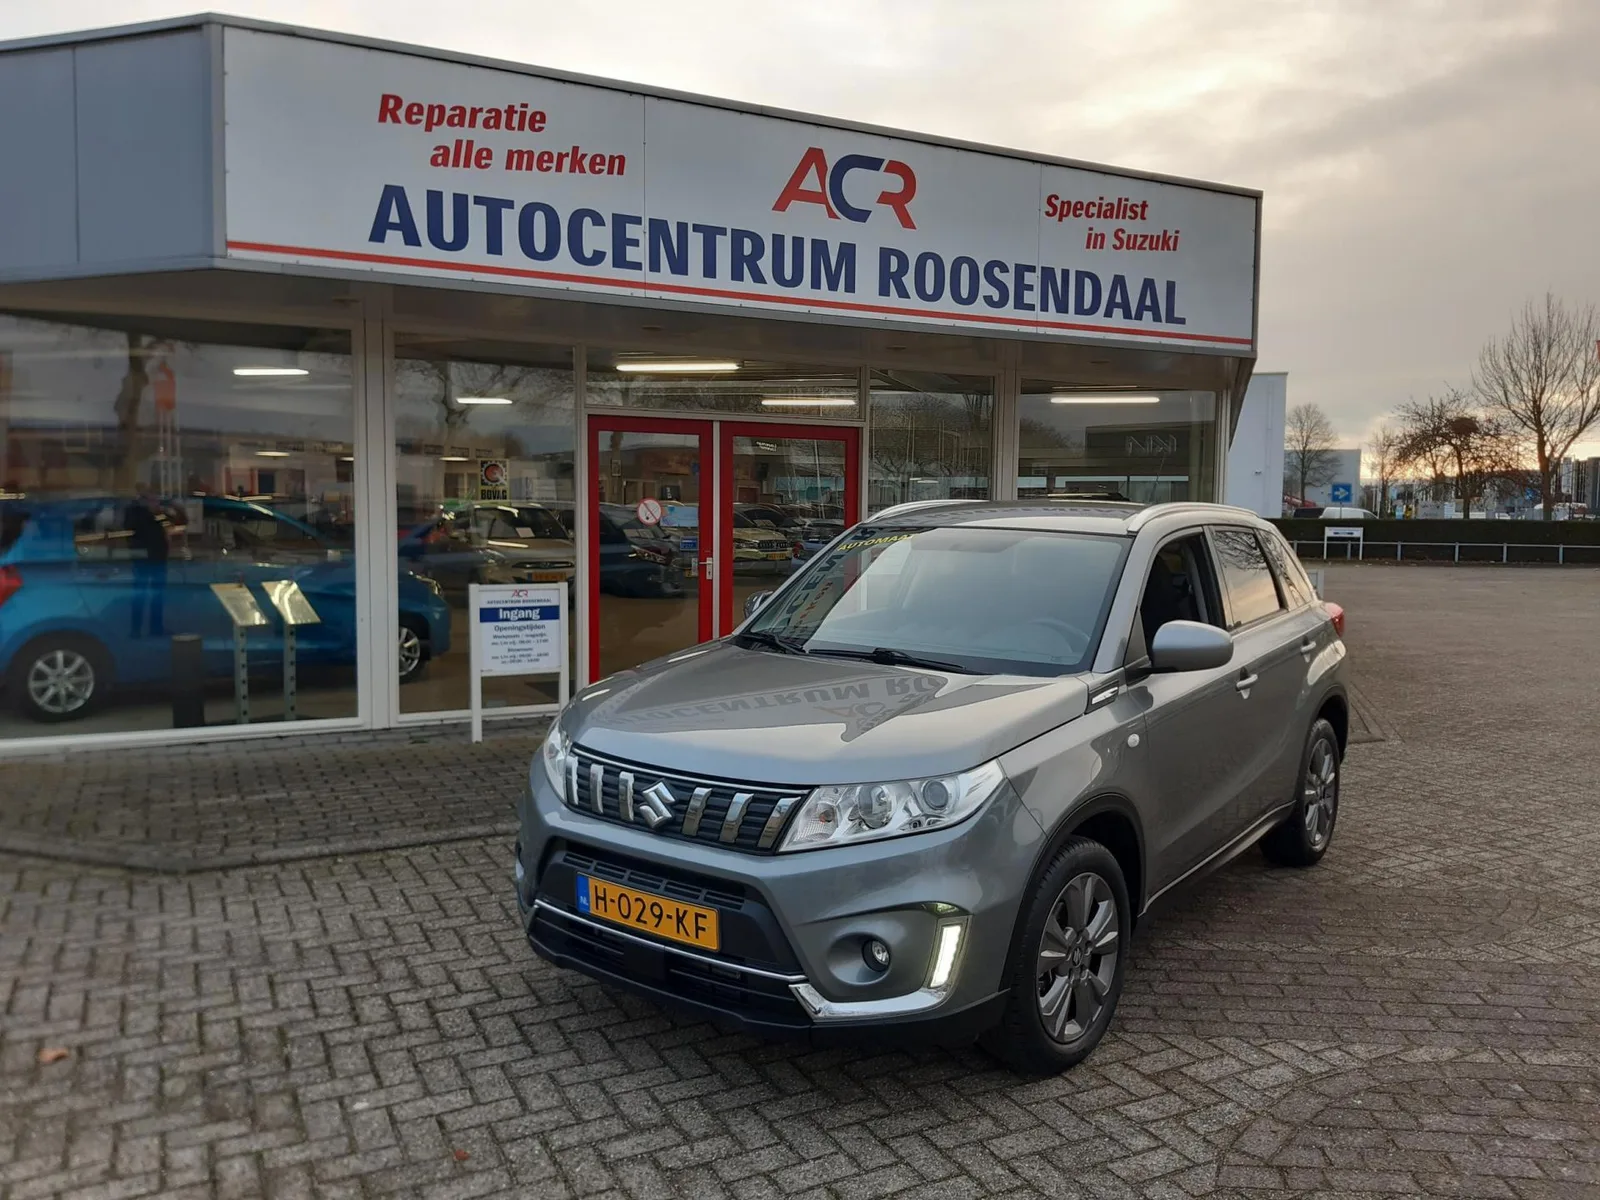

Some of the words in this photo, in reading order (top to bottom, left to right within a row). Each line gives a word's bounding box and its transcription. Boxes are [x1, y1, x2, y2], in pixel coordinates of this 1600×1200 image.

[378, 93, 547, 134] Reparatie
[429, 139, 493, 169] alle
[504, 148, 626, 176] merken
[772, 147, 917, 230] ACR
[1044, 194, 1149, 222] Specialist
[368, 184, 856, 294] AUTOCENTRUM
[878, 247, 1187, 326] ROOSENDAAL
[1085, 226, 1106, 250] in
[1111, 229, 1180, 253] Suzuki
[494, 624, 546, 632] Openingstijden
[499, 608, 541, 621] Ingang
[595, 885, 707, 939] H-029-KF
